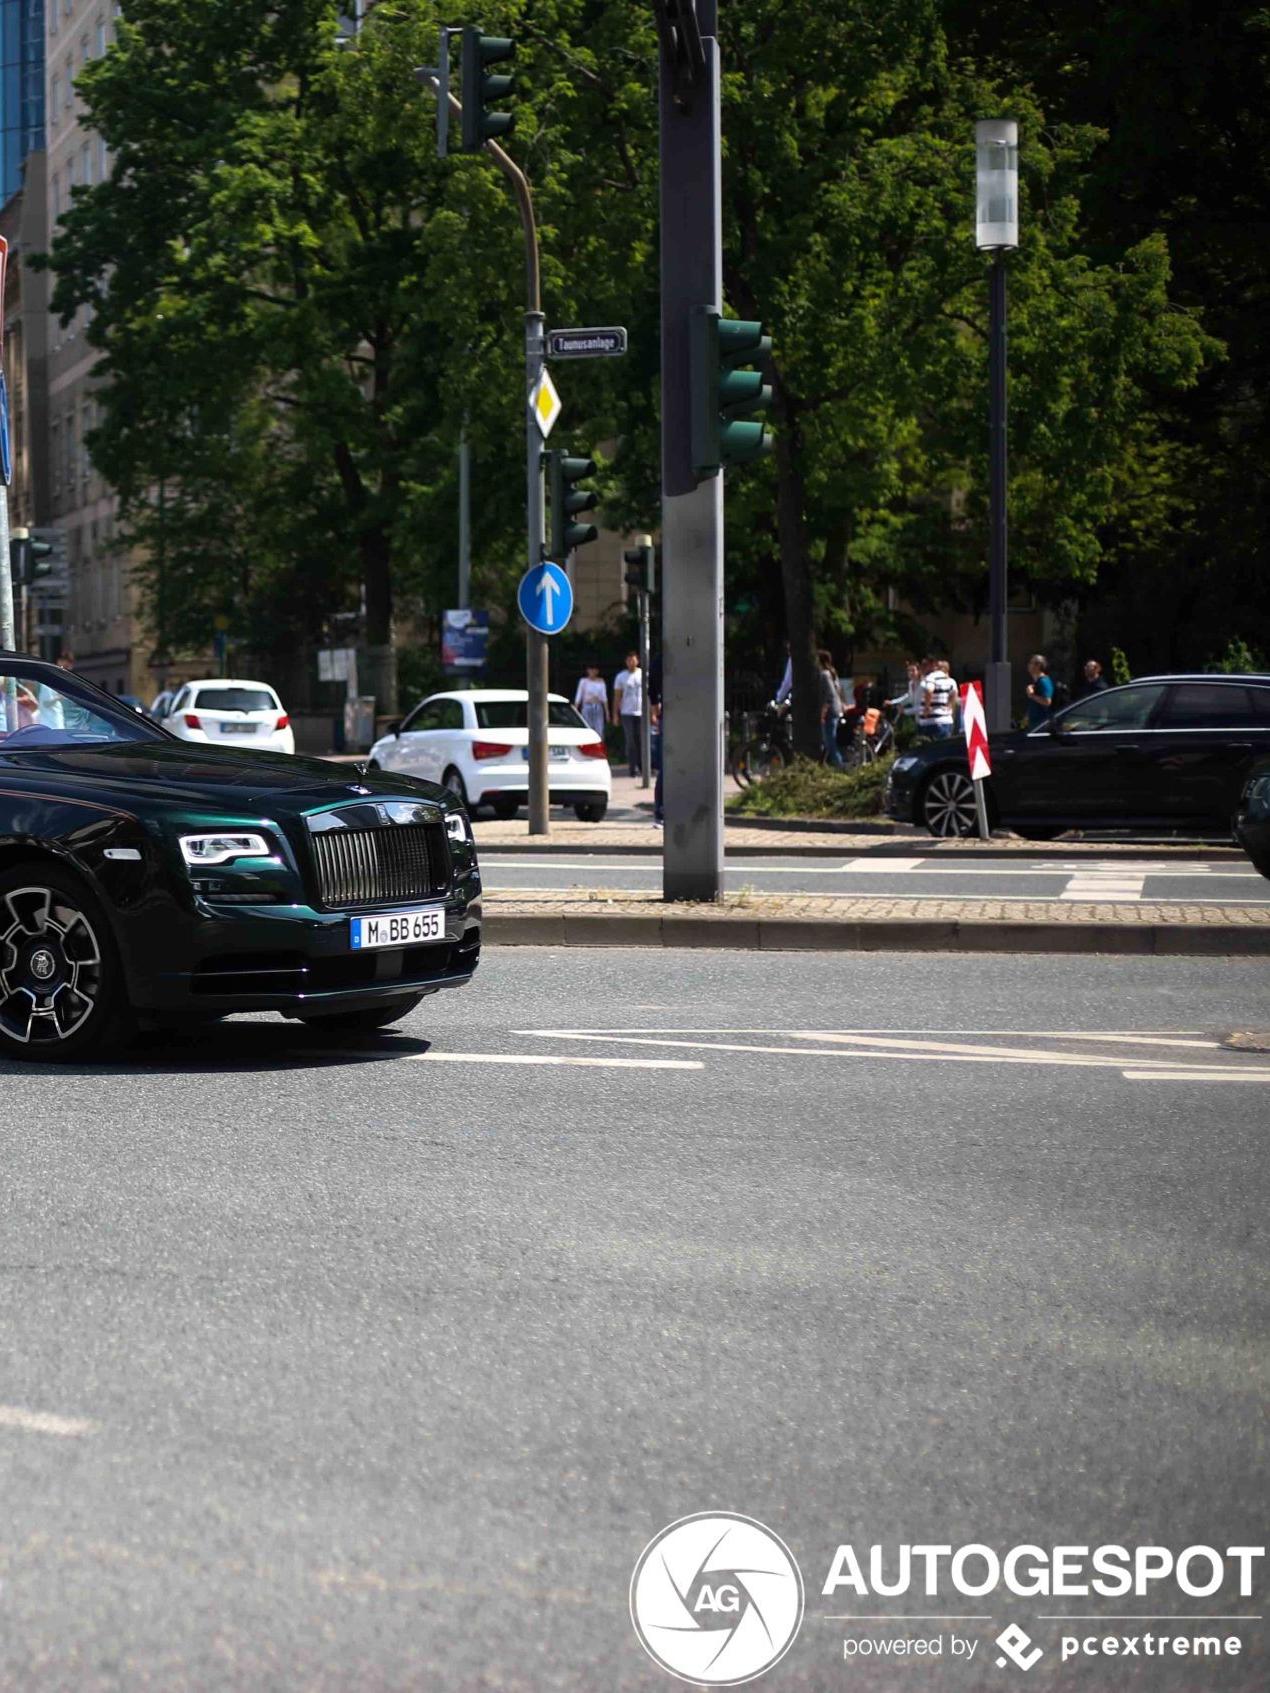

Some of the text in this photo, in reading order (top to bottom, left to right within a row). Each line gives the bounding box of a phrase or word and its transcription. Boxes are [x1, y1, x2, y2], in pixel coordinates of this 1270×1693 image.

[558, 336, 615, 350] Taunusanlage
[368, 914, 439, 944] M BB 655
